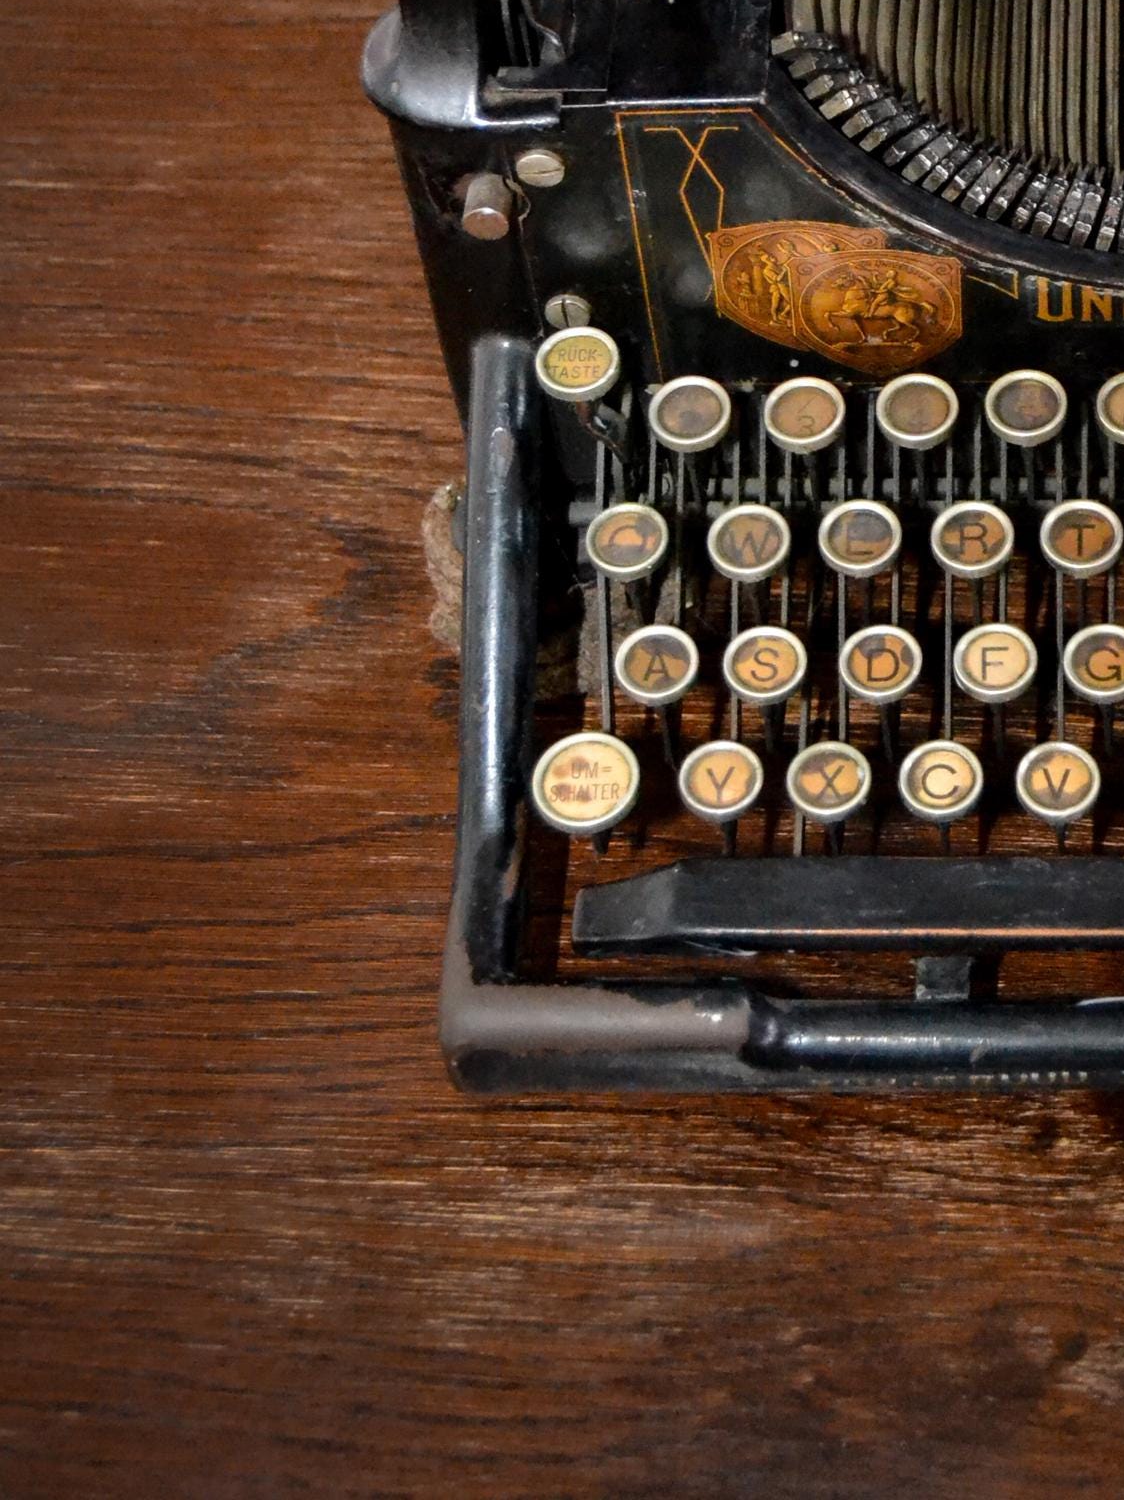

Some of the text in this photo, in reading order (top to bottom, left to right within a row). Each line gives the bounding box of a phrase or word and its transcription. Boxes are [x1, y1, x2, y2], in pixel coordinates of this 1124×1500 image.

[551, 365, 601, 379] TASTE
[728, 531, 779, 564] W
[960, 521, 988, 555] R
[1063, 523, 1096, 557] T
[643, 650, 671, 682] A
[750, 647, 779, 683] S
[867, 647, 900, 683] D
[981, 646, 1009, 681] F
[1084, 645, 1122, 682] G
[549, 783, 621, 803] SCHALTER
[706, 765, 736, 803] Y
[815, 764, 845, 800] X
[920, 763, 960, 800] C
[1042, 767, 1070, 799] V
